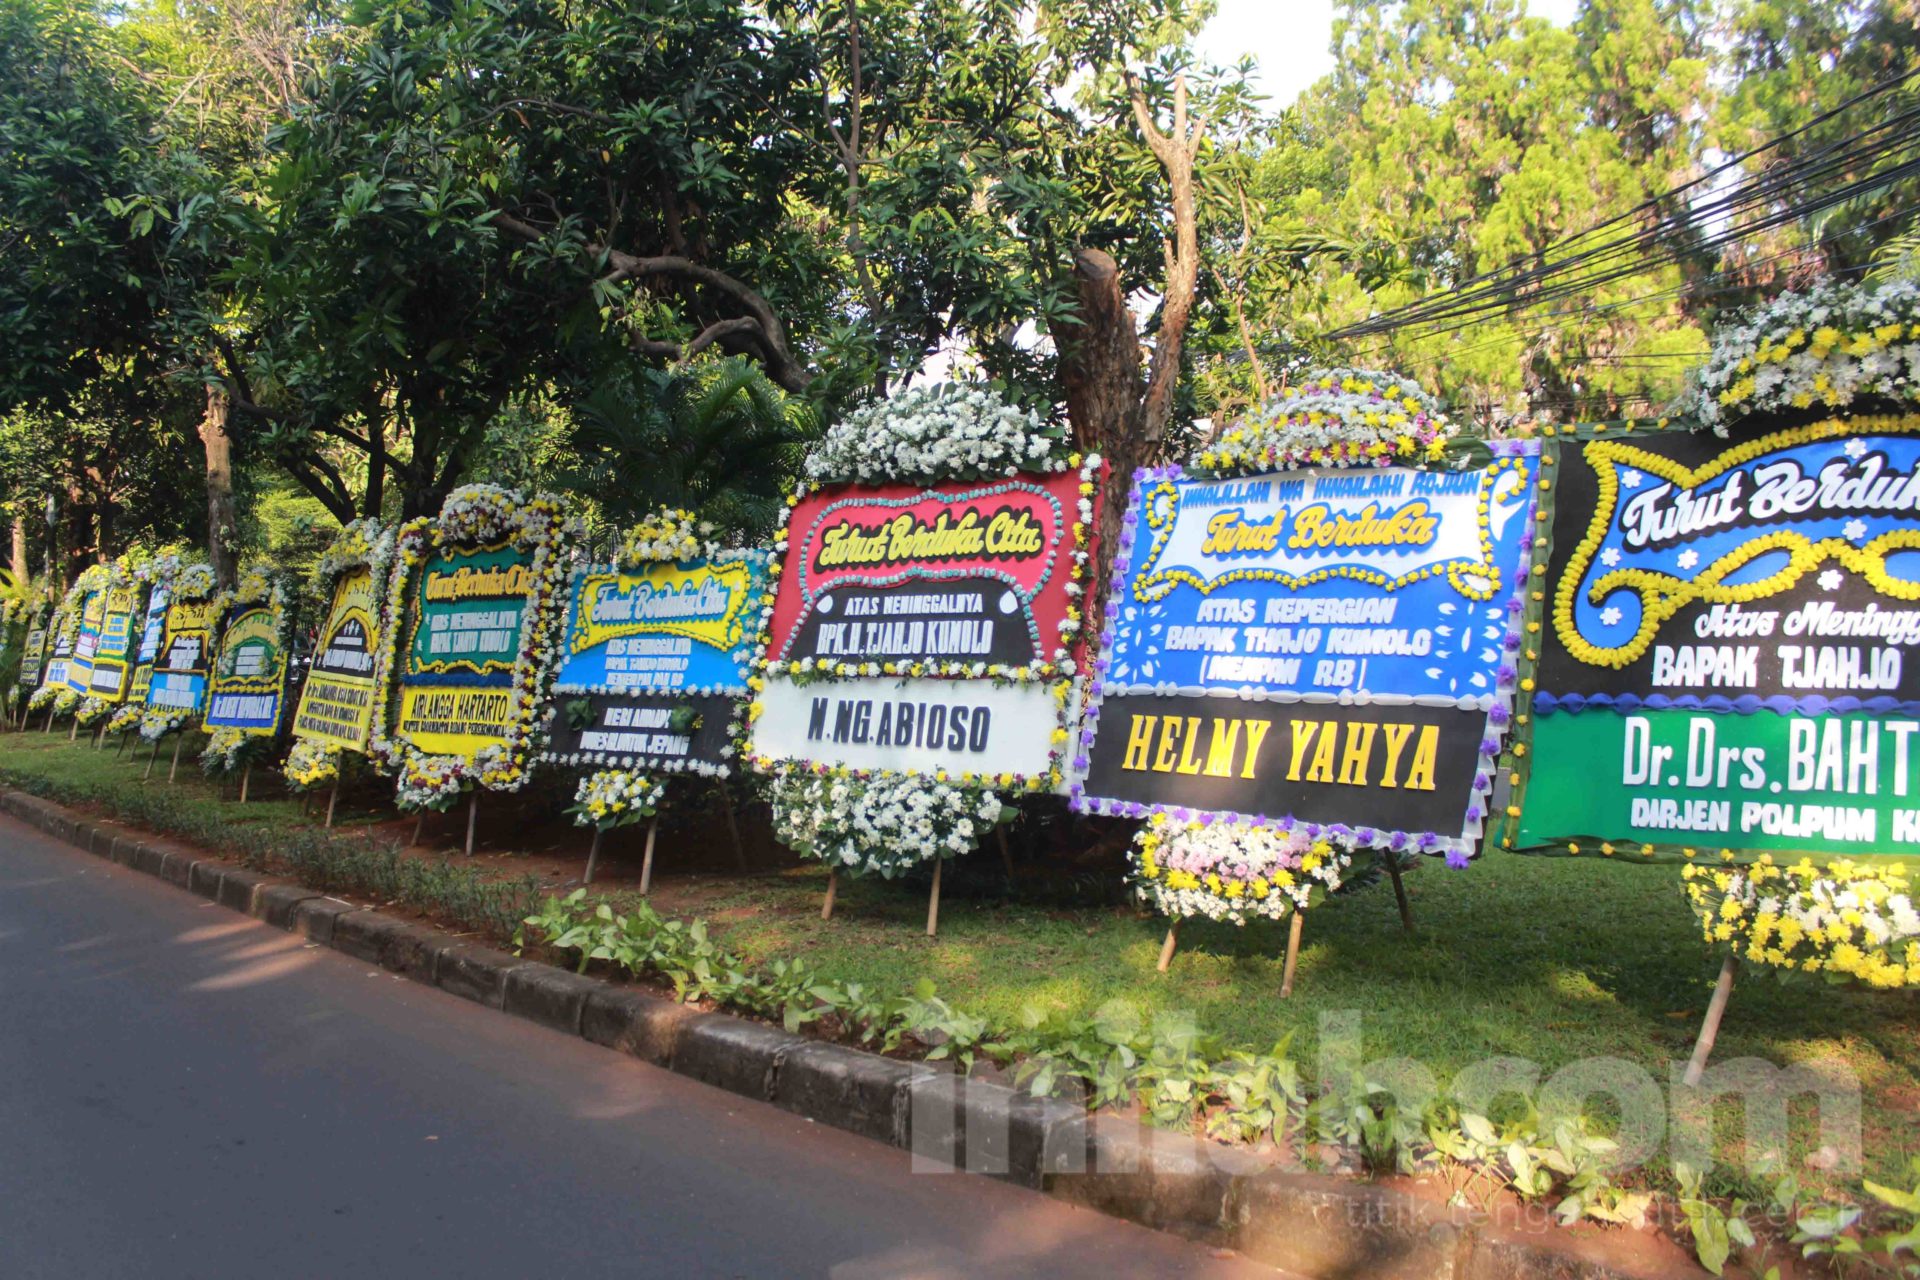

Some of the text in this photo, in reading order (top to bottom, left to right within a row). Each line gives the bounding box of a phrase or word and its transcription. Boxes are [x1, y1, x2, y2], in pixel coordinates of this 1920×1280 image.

[1279, 479, 1305, 501] WA
[1622, 470, 1746, 546] Turut
[819, 511, 1042, 566] Turut Berduka Cita
[1202, 502, 1437, 555] Turut Berduka
[634, 584, 697, 619] Berduka
[844, 597, 880, 616] ATAS
[1196, 598, 1398, 625] ATAS KEPERGIAN
[925, 620, 994, 655] KUMOLO
[1695, 604, 1779, 638] Atas
[1165, 625, 1238, 652] BAPAK
[1325, 627, 1432, 657] KUMOLO
[1652, 645, 1901, 689] BAPAK TJAHJO
[412, 694, 508, 722] AIRLANGGA HARTARTO
[1122, 714, 1440, 791] HELMY YAHYA
[1631, 798, 1731, 833] DIRJEN
[1741, 802, 1876, 842] POLPUM
